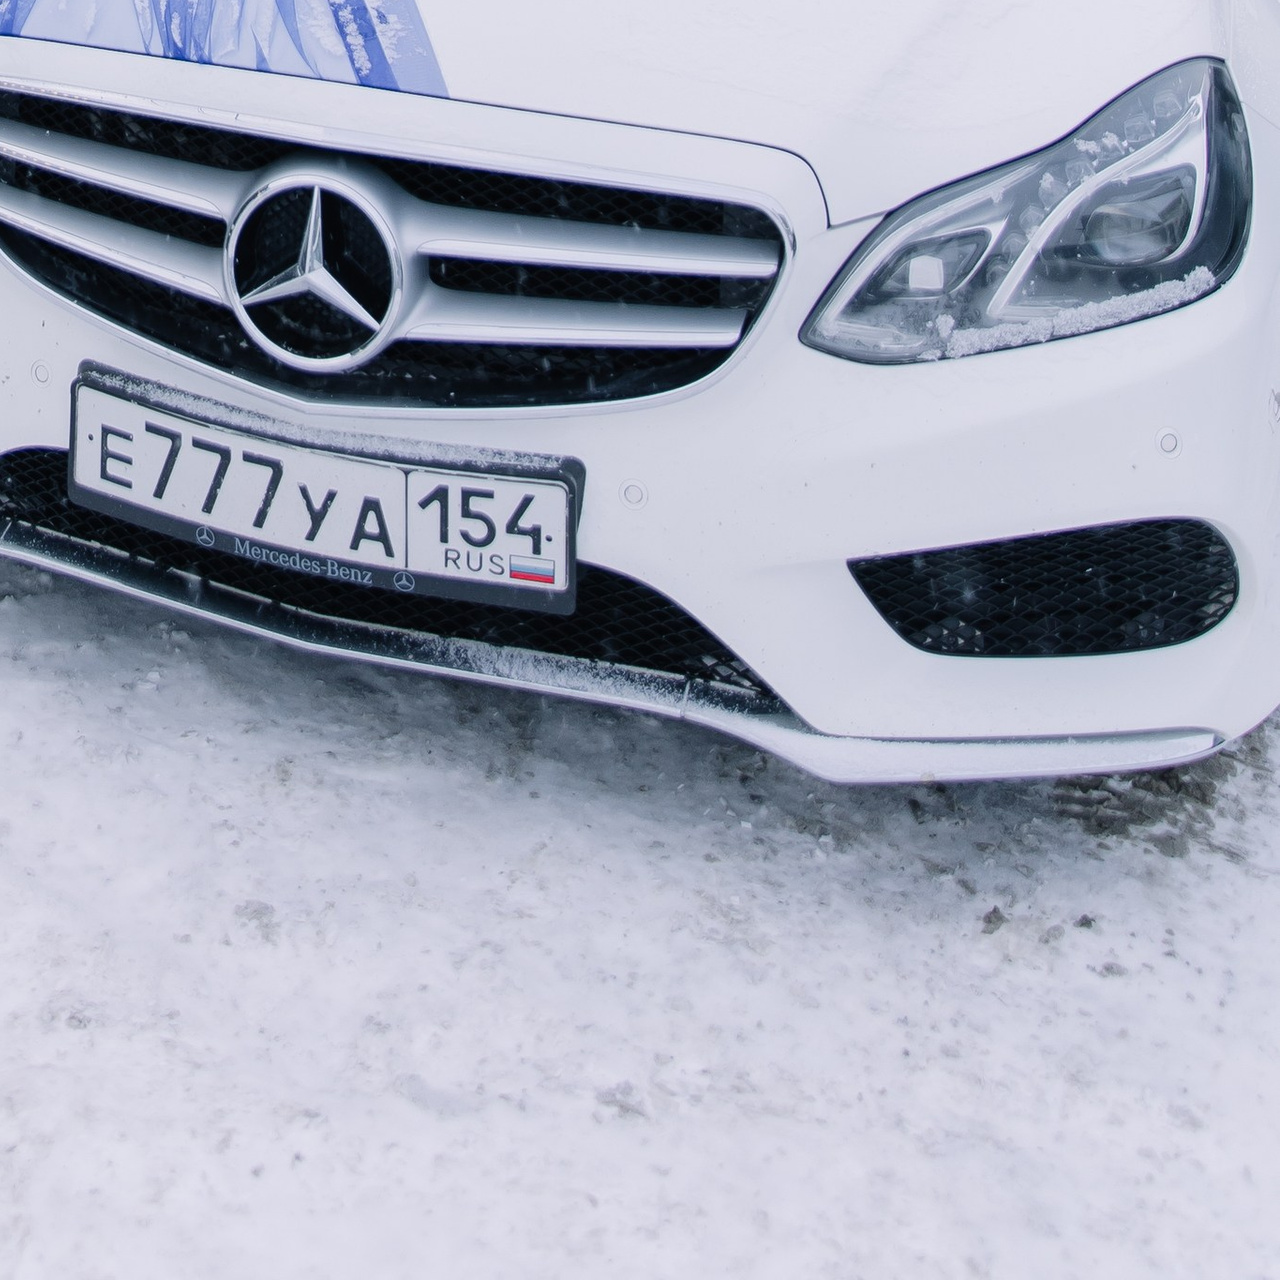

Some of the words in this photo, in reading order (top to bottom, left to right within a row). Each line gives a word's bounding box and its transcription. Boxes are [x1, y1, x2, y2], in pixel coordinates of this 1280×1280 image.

[418, 483, 543, 556] 154
[233, 536, 373, 585] Mercedes-Benz
[443, 547, 506, 577] RUS
